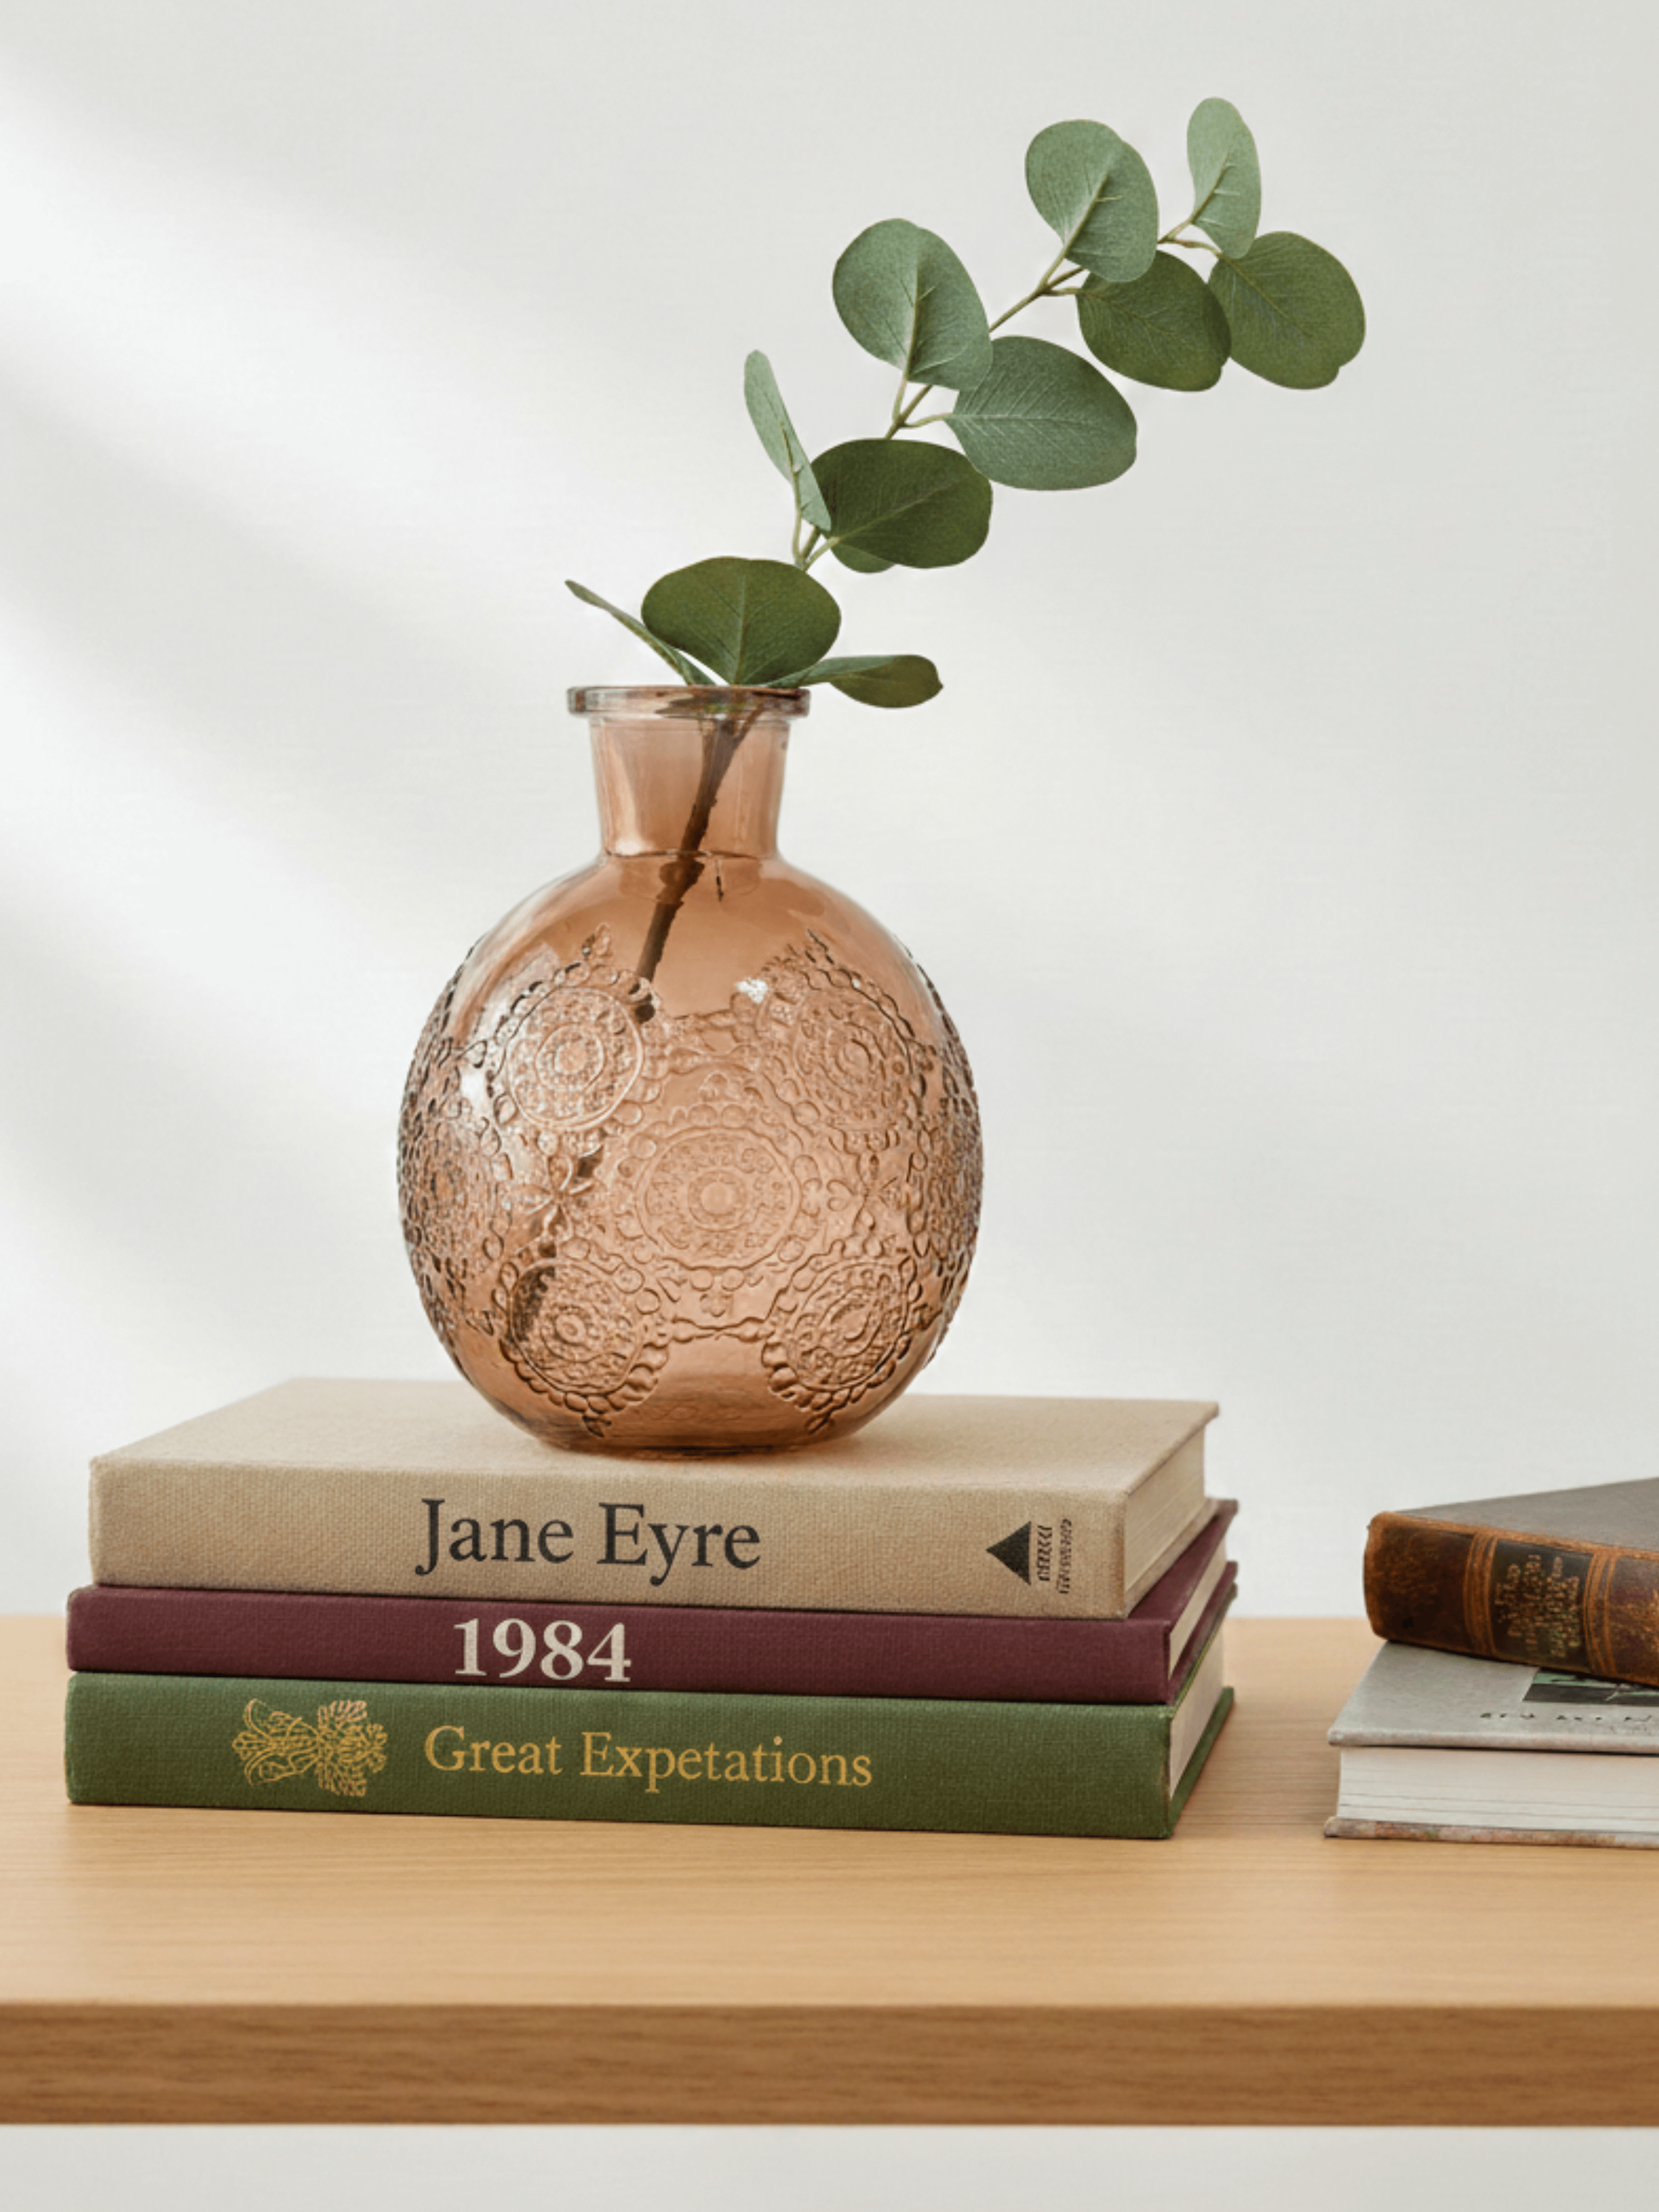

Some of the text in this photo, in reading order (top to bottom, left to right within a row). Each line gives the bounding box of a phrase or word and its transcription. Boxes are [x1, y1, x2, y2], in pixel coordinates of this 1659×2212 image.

[415, 1498, 761, 1586] Jane Eyre
[453, 1618, 631, 1682] 1984
[424, 1725, 873, 1793] Great Expetations
